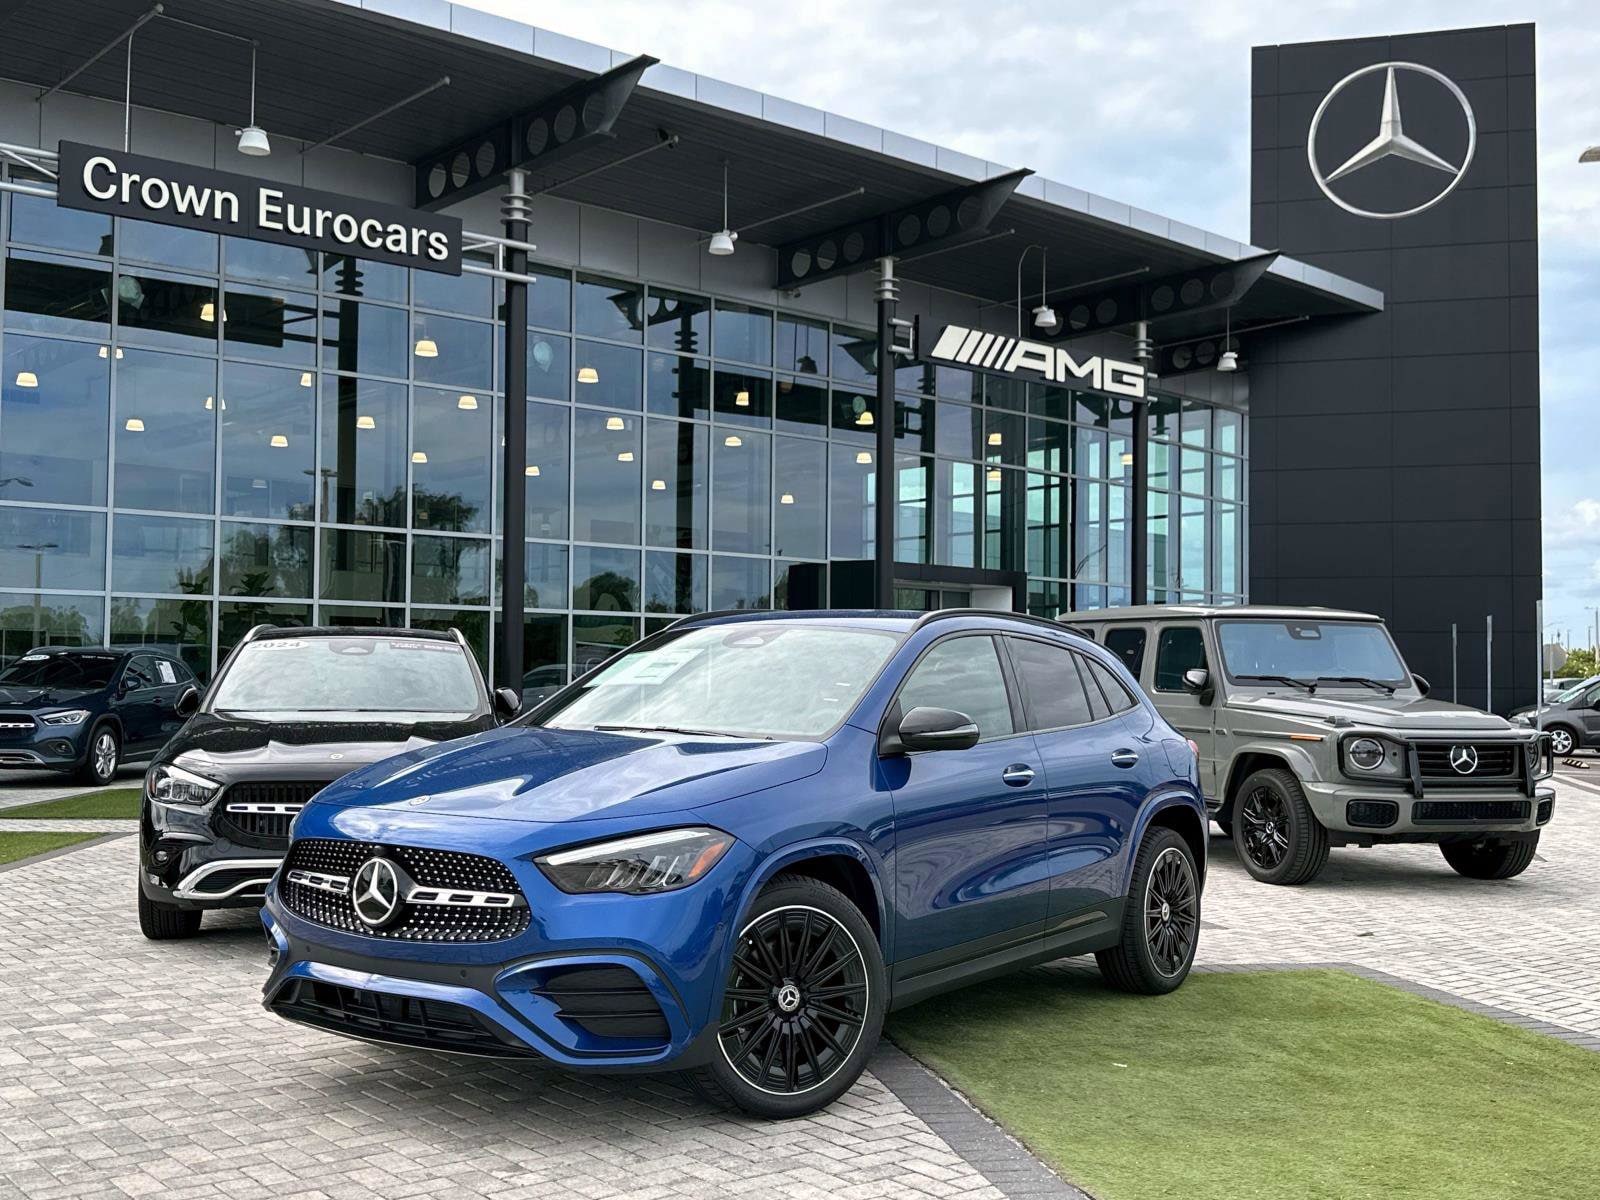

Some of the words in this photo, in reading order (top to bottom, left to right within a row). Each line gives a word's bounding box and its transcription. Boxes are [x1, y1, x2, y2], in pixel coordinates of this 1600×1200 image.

[82, 156, 240, 224] Crown
[257, 187, 450, 262] Eurocars
[1003, 339, 1145, 398] AMG
